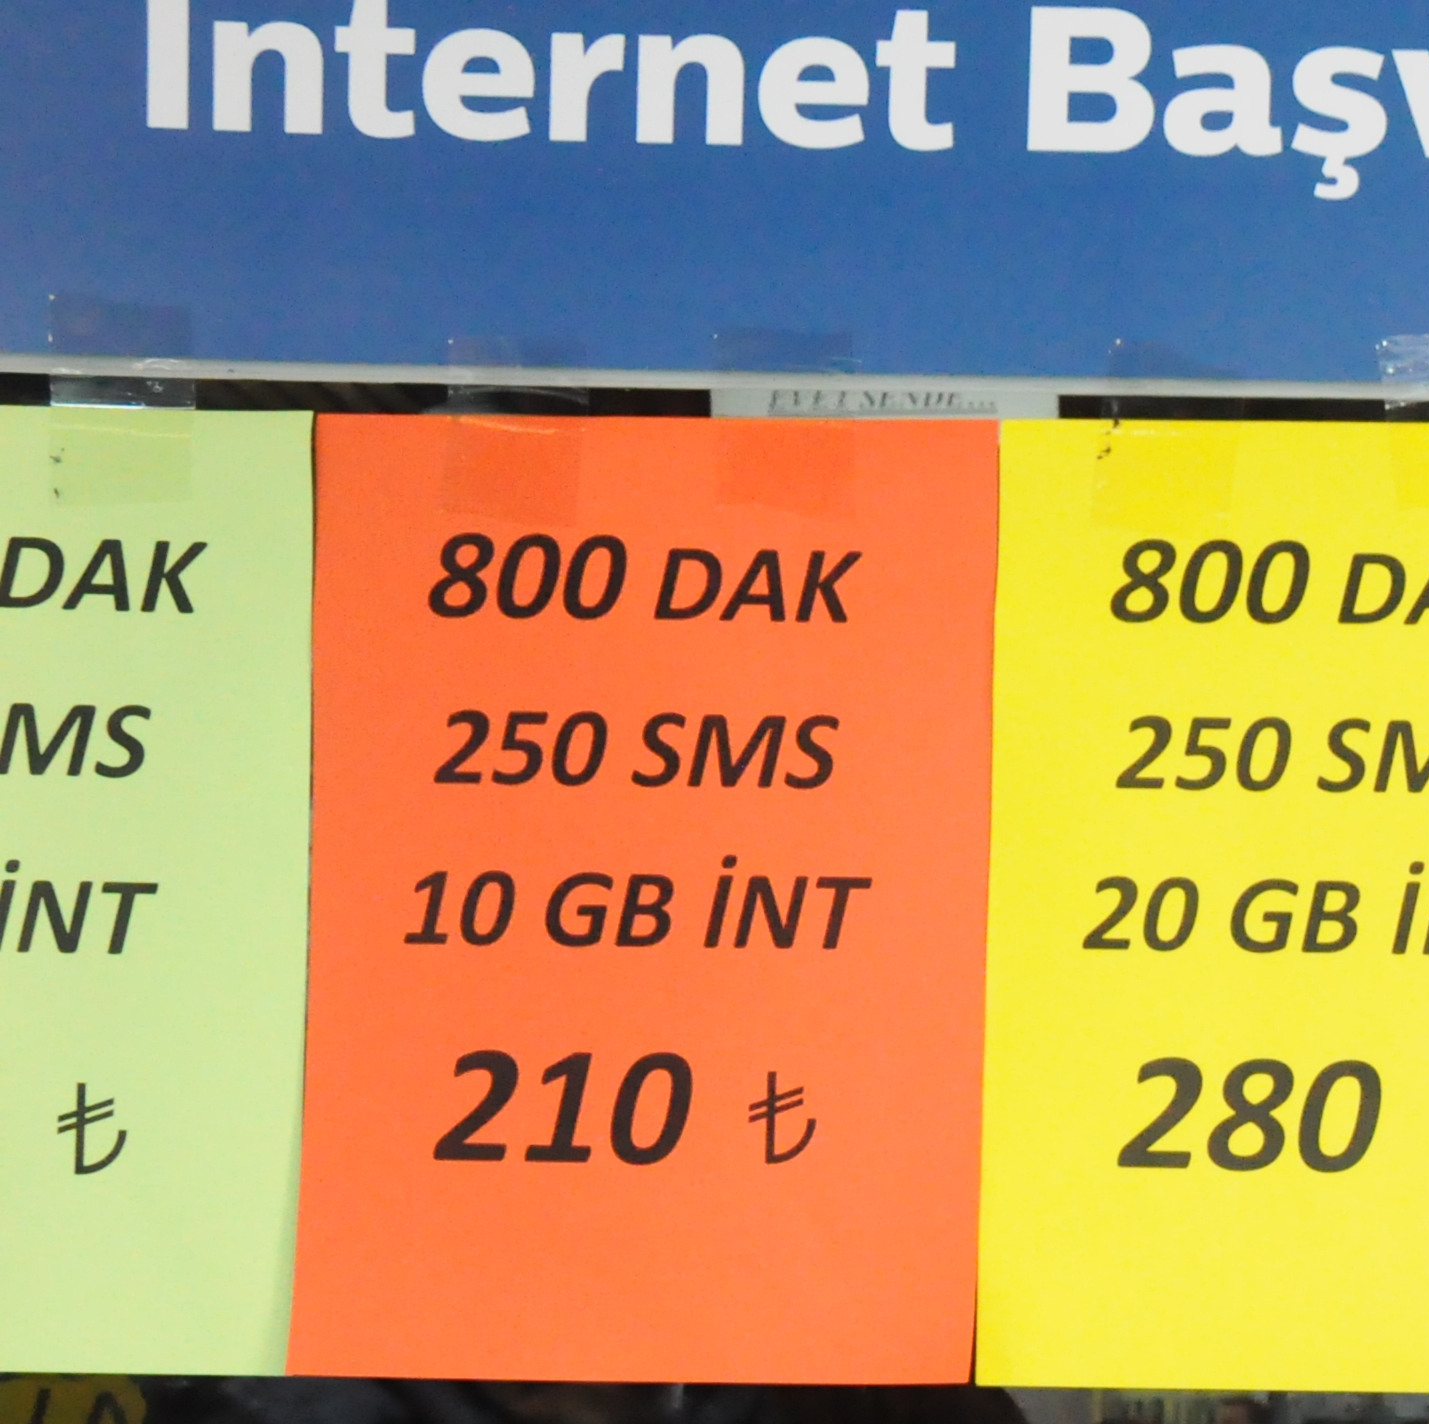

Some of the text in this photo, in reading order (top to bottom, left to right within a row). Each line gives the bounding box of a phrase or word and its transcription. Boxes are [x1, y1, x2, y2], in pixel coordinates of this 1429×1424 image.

[0, 536, 208, 614] DAK
[427, 532, 863, 623] 800 DAK
[1110, 538, 1311, 625] 800
[0, 702, 152, 779] MS
[433, 709, 840, 790] 250 SMS
[1115, 715, 1292, 792] 250
[0, 859, 159, 955] İNT
[403, 854, 873, 950] 10 GB İNT
[1082, 875, 1200, 952] 20
[1230, 878, 1361, 954] GB
[433, 1049, 693, 1166] 210
[1117, 1056, 1382, 1173] 280
